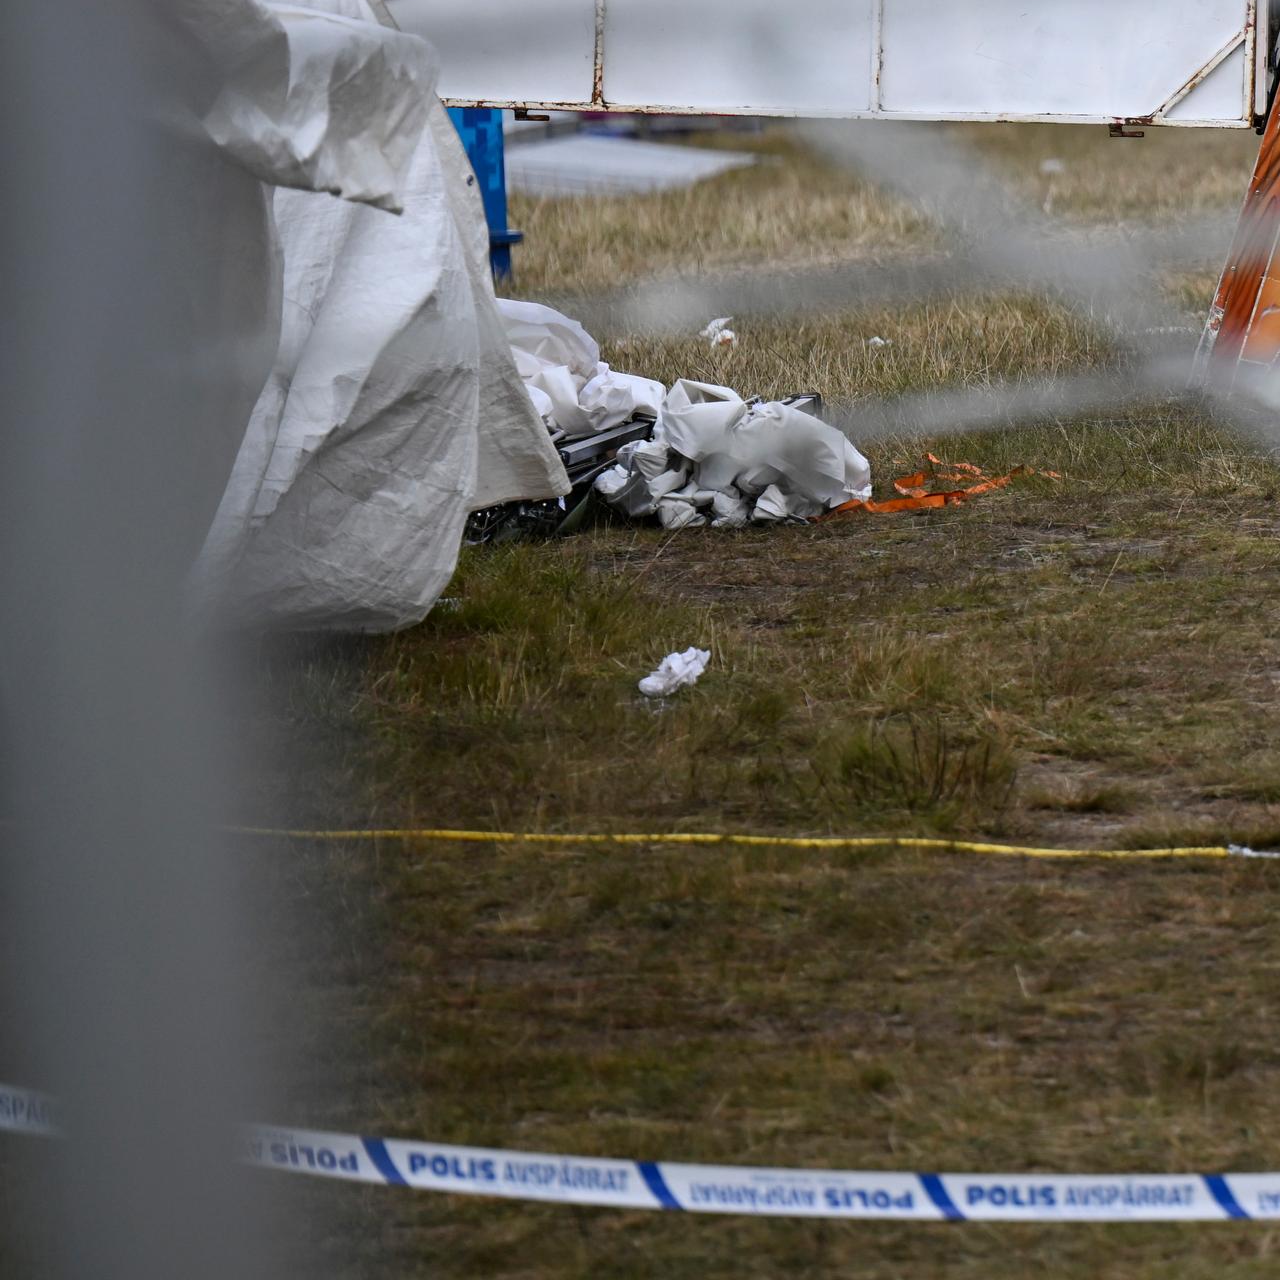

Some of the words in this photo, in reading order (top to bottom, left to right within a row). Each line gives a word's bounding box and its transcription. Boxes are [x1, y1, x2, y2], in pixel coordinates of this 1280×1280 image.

[270, 1142, 359, 1171] POLIS
[408, 1152, 497, 1180] POLIS
[825, 1186, 913, 1209] POLIS
[966, 1185, 1056, 1207] POLIS
[1065, 1180, 1195, 1207] AVSPÄRRAT
